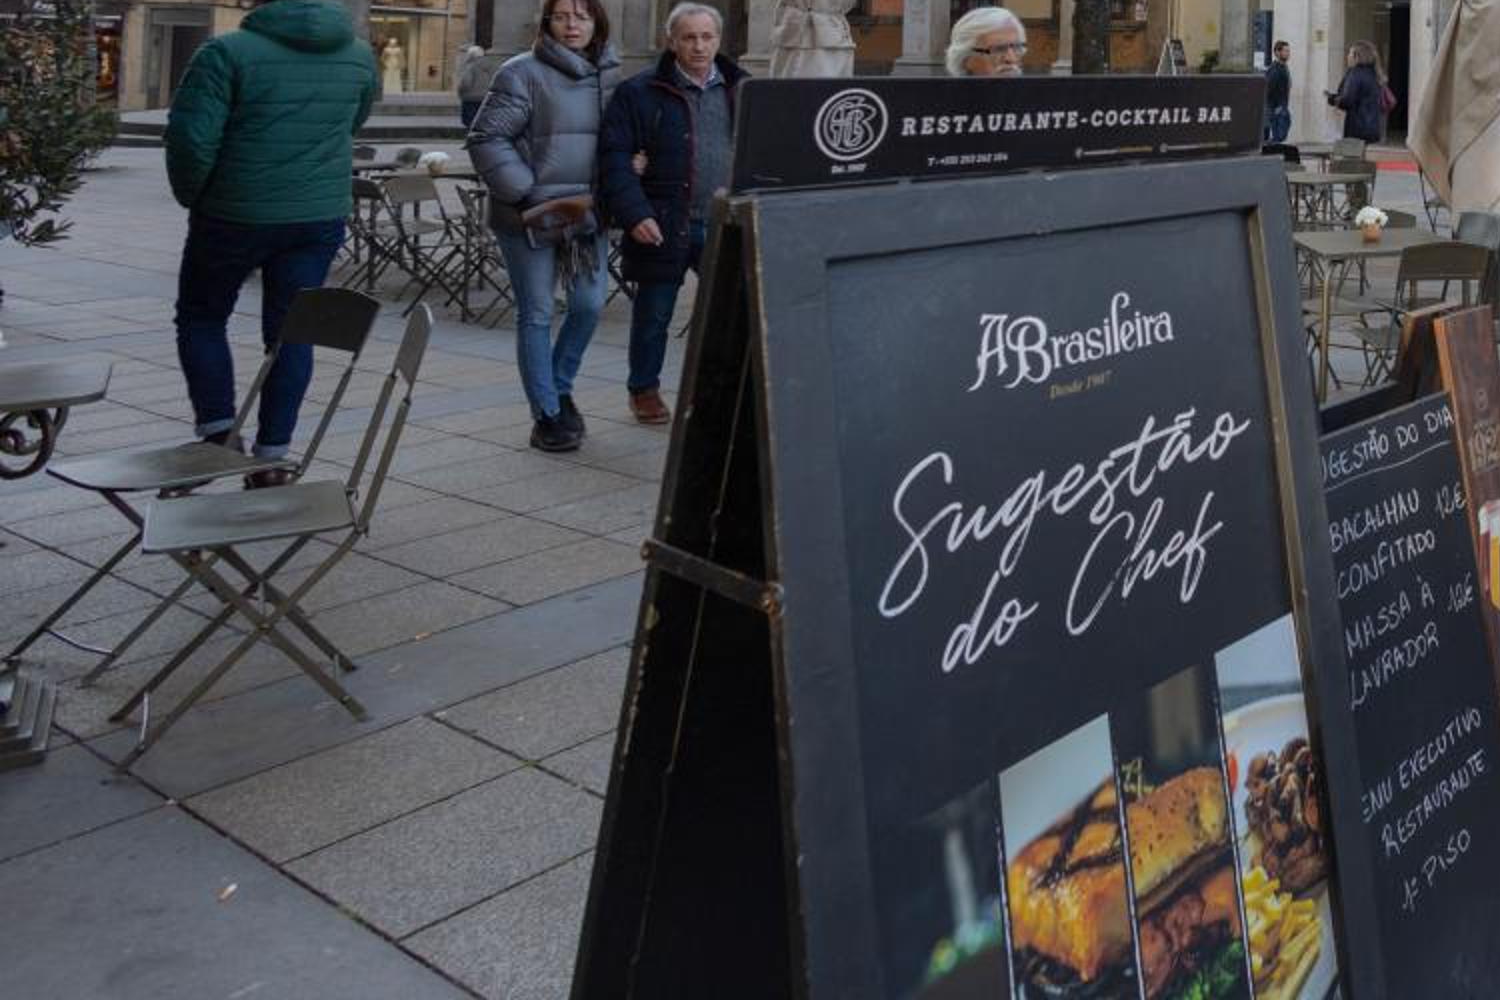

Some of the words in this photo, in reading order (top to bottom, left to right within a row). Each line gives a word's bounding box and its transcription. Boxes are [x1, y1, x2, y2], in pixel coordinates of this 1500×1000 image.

[1197, 105, 1232, 123] BAR
[1321, 428, 1389, 482] GESTÃO
[1396, 422, 1419, 448] DO
[1424, 403, 1456, 434] DIA
[878, 406, 1251, 617] Sugestão
[1328, 487, 1420, 553] BACALHAU
[941, 570, 1039, 673] do
[1065, 491, 1223, 636] Chef
[1336, 529, 1436, 600] CONFITADO
[1344, 596, 1412, 659] MASSA
[1349, 621, 1440, 711] LAVRADOR
[1361, 776, 1393, 824] ENU
[1399, 706, 1482, 790] EXECUTIVO
[1381, 748, 1488, 857] RESTAURANTE
[1422, 828, 1471, 888] PISO
